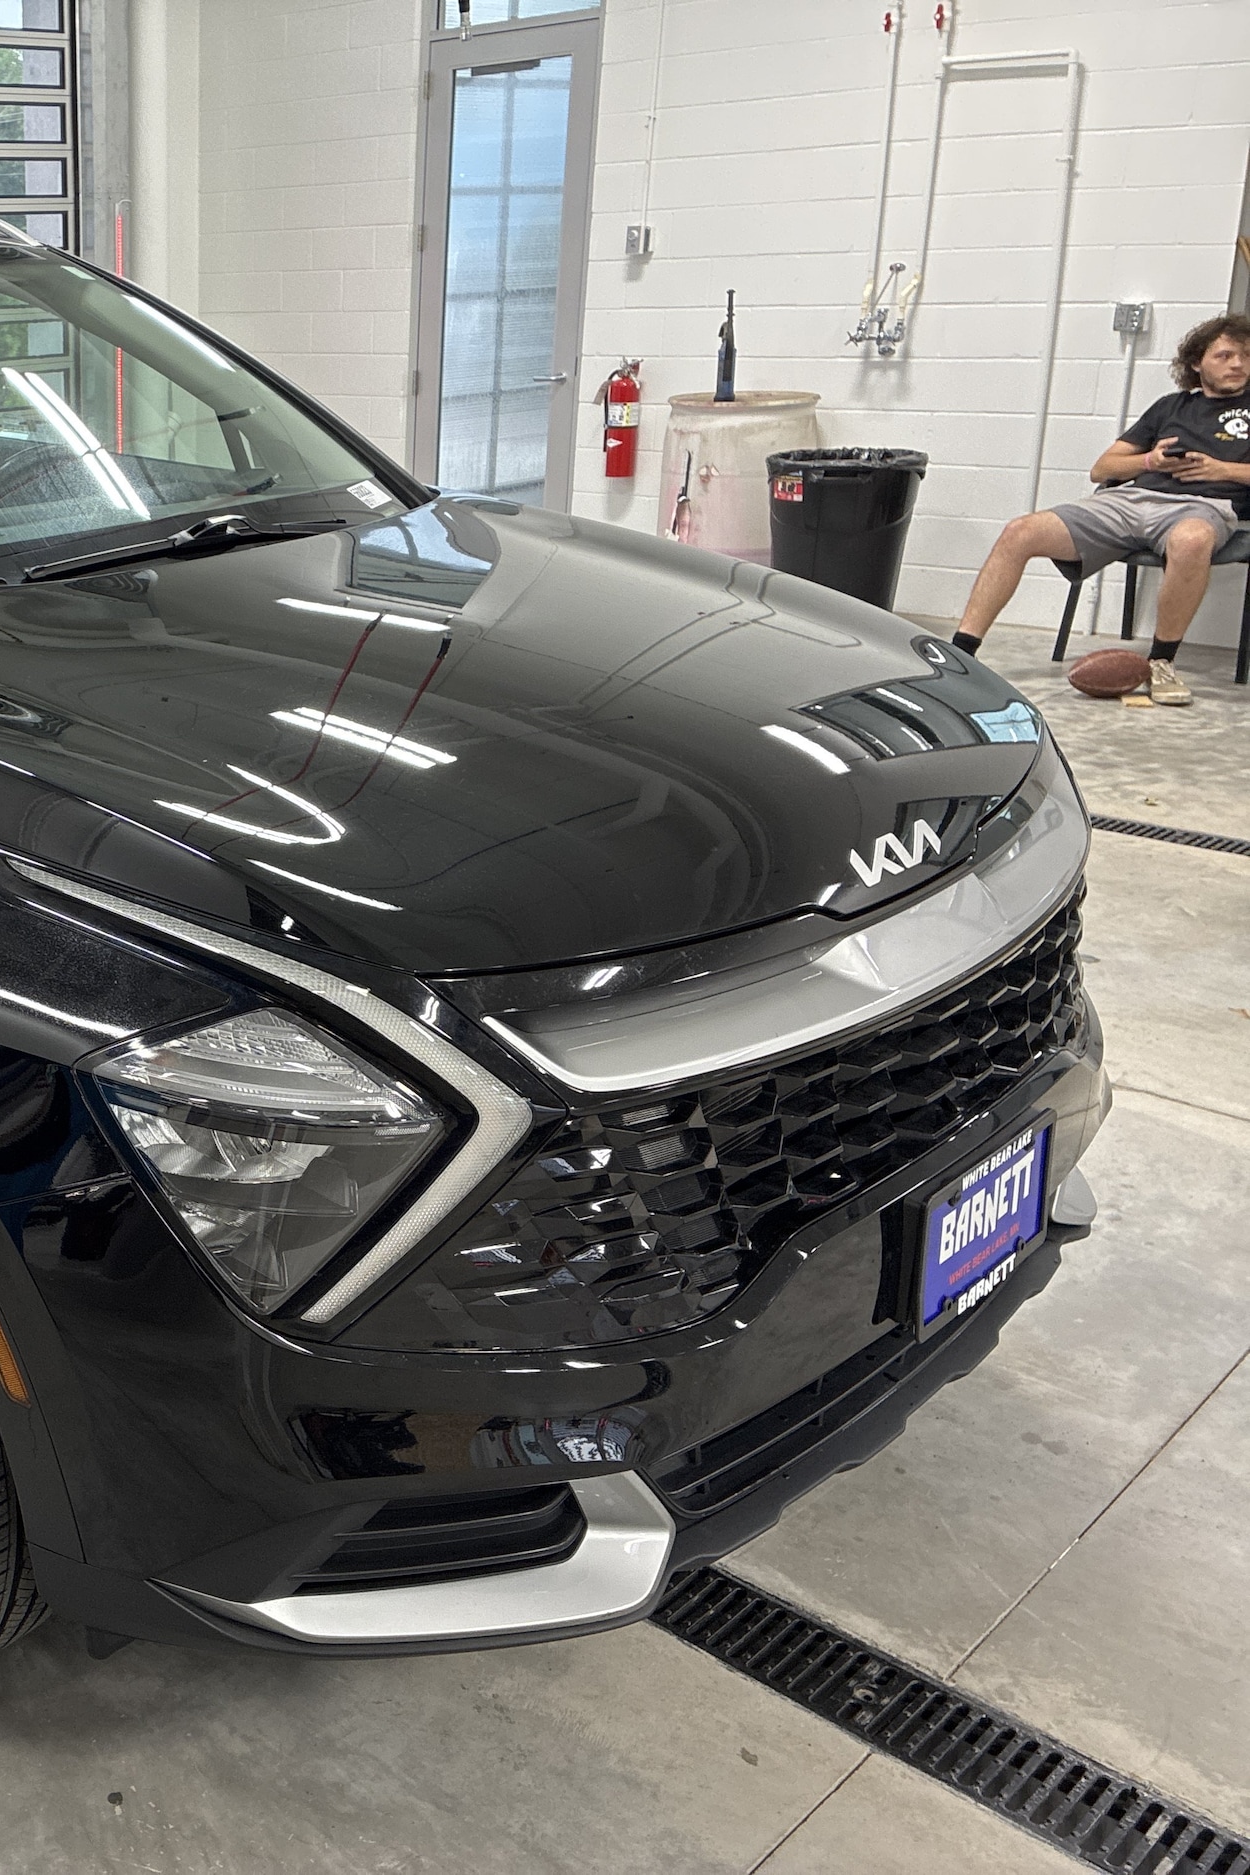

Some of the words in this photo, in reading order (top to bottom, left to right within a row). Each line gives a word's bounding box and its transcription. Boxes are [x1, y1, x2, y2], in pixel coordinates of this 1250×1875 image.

[1218, 408, 1250, 424] CHICA
[849, 818, 942, 888] KIA
[962, 1160, 990, 1192] WHITE
[990, 1144, 1012, 1173] BEAR
[1012, 1128, 1033, 1156] LAKE
[938, 1147, 1036, 1266] BARNETT
[948, 1261, 972, 1286] WHITE
[972, 1245, 991, 1270] BEAR
[957, 1251, 1017, 1316] BARNETT
